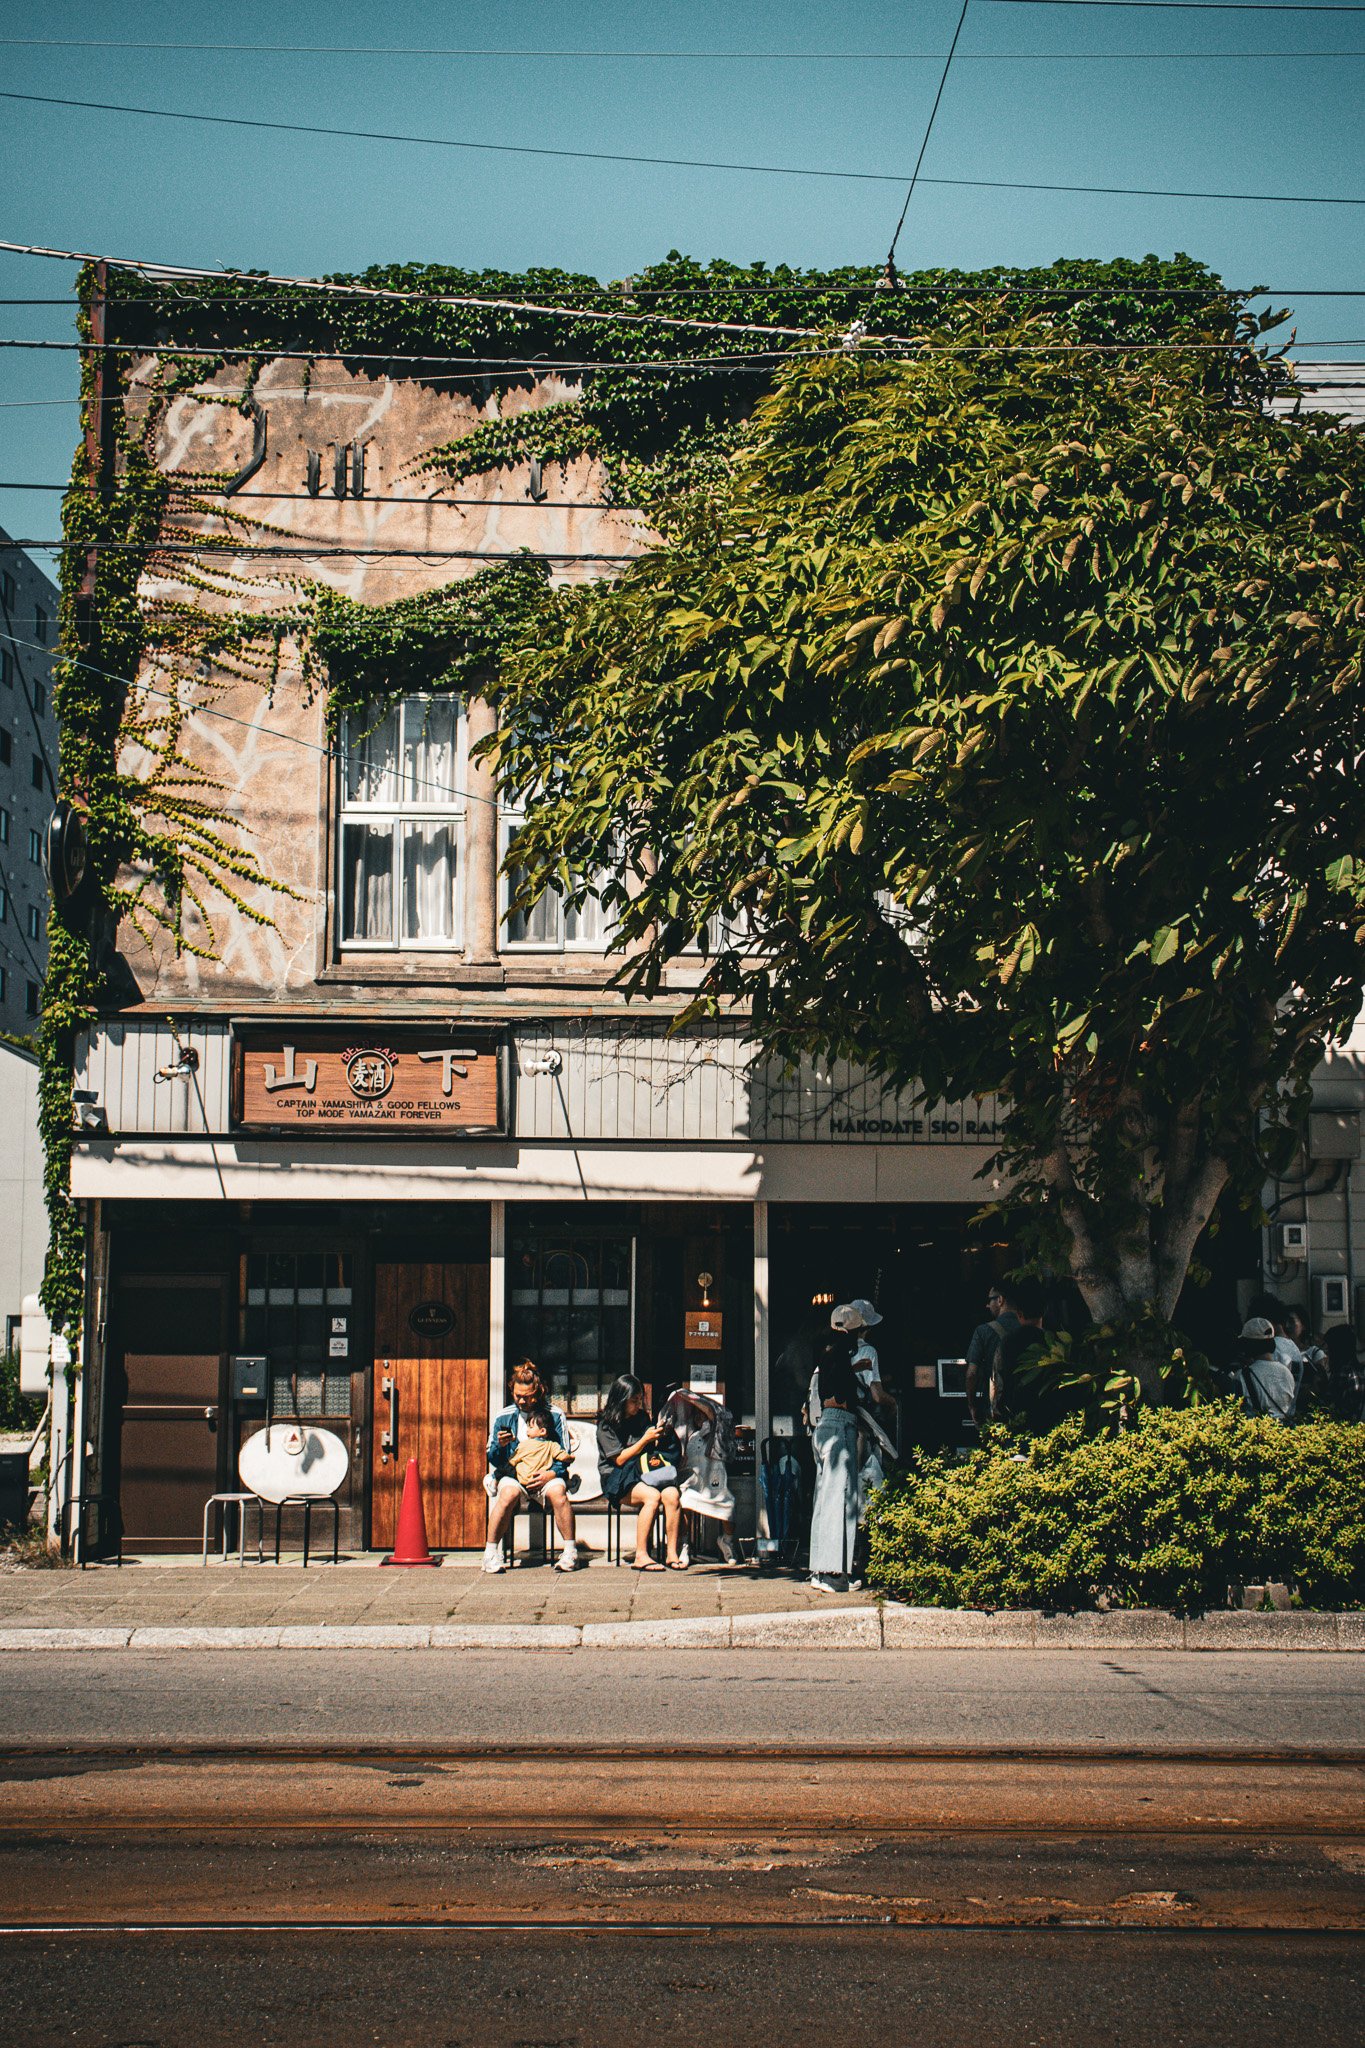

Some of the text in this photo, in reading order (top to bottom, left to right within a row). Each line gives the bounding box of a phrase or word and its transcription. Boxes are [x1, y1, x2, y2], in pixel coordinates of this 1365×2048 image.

[341, 1041, 399, 1066] BEER BAR
[263, 1044, 477, 1093] 山 下
[352, 1058, 387, 1089] 麦酒
[276, 1099, 461, 1110] CAPTAIN YAMASHITA & GOOD FELLOWS
[296, 1110, 442, 1119] TOP MODE YAMAZAKI FOREVER
[829, 1119, 923, 1134] HAKODATE
[931, 1119, 960, 1134] SIO
